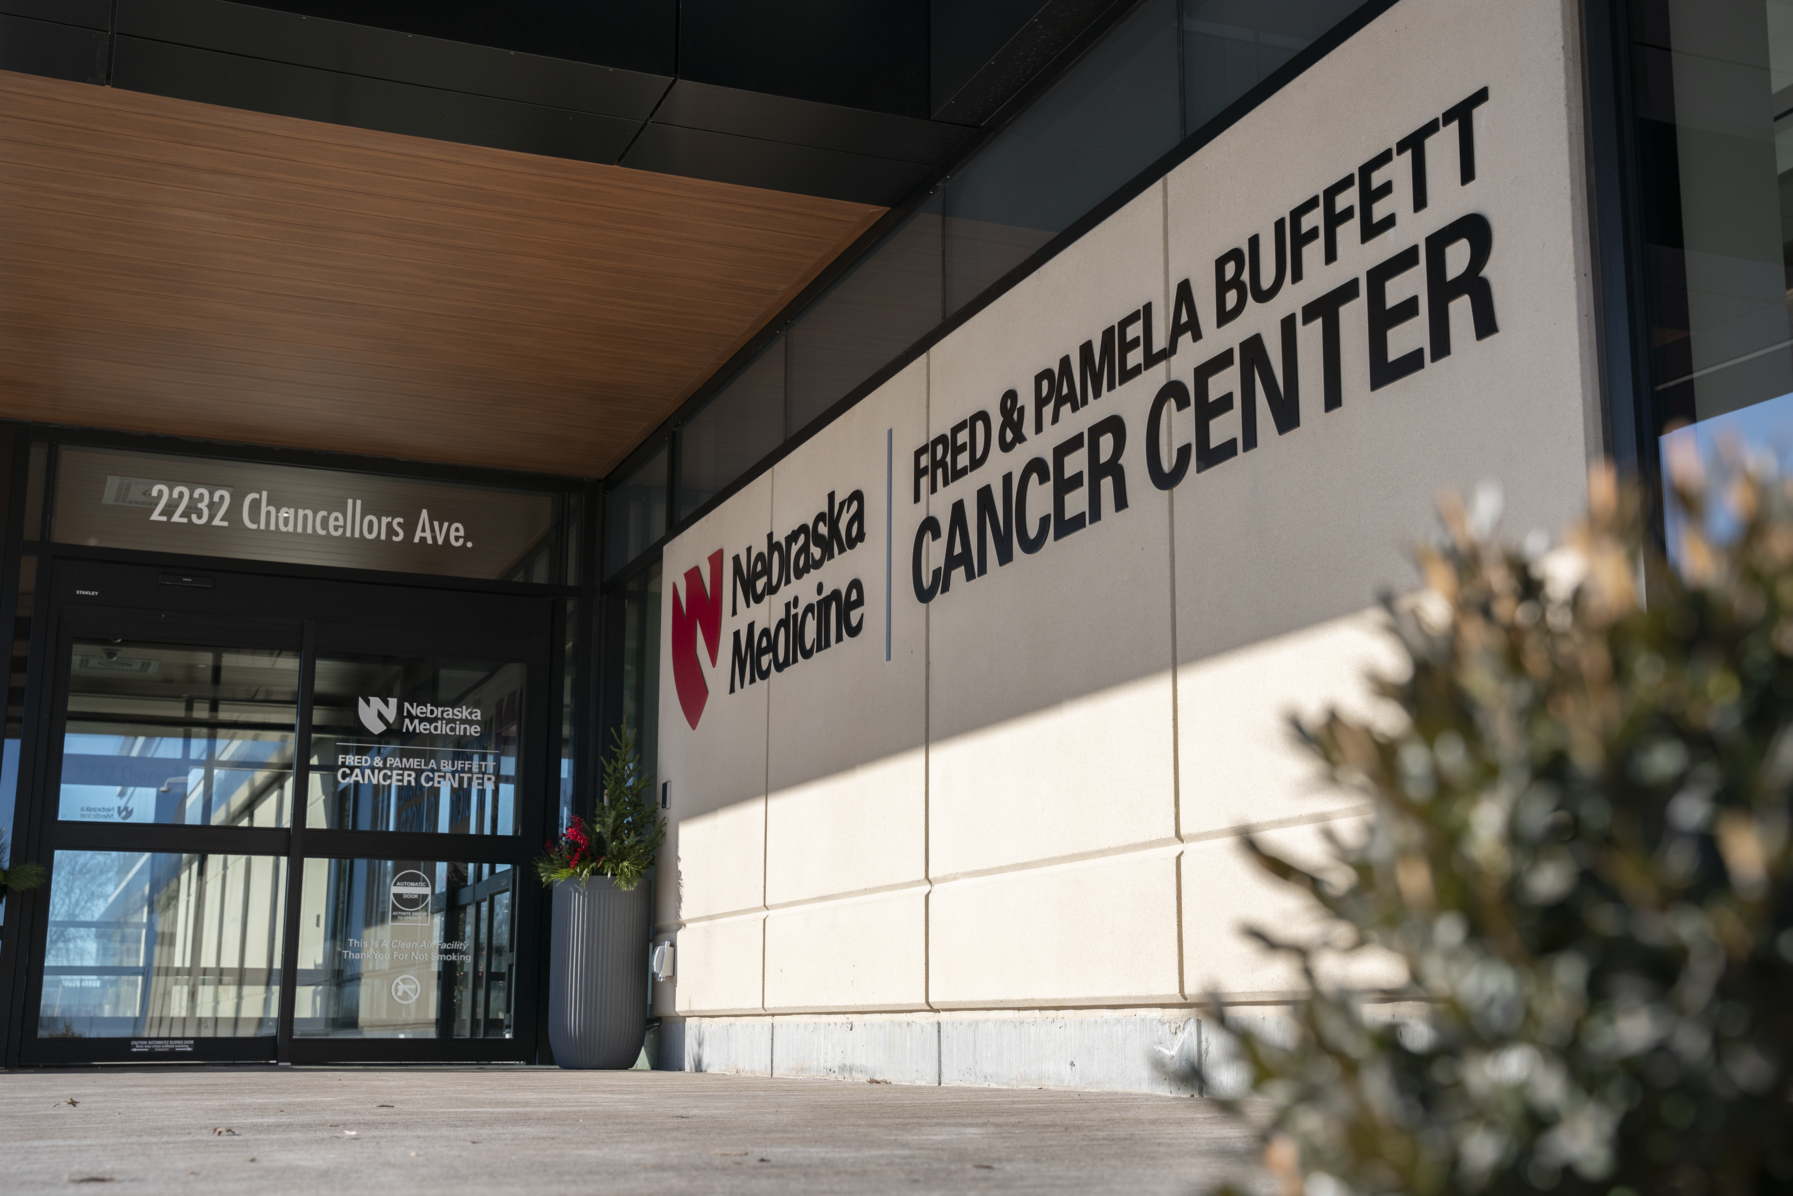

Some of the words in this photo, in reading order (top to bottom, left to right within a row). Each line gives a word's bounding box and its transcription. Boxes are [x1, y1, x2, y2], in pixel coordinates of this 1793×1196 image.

[913, 409, 992, 504] FRED
[998, 388, 1026, 453] &
[1034, 278, 1203, 435] PAMELA
[1214, 86, 1489, 329] BUFFETT
[912, 414, 1129, 604] CANCER
[1145, 212, 1499, 490] CENTER
[149, 484, 231, 526] 2232
[242, 490, 404, 542] Chancellors
[413, 508, 473, 548] Ave.
[731, 489, 866, 618] Nebraska
[729, 578, 865, 695] Medicine
[403, 702, 481, 720] Nebraska
[402, 719, 481, 736] Medicine
[338, 755, 371, 767] FRED
[373, 756, 383, 767] &
[386, 757, 437, 770] PAMELA
[440, 760, 496, 772] BUFFETT
[337, 768, 416, 786] CANCER
[420, 772, 495, 789] CENTER
[348, 939, 368, 948] This
[371, 940, 378, 948] Is
[381, 940, 388, 948] A
[391, 940, 417, 949] Clean
[419, 941, 433, 949] Air
[437, 941, 469, 951] Facility
[342, 951, 371, 960] Thank
[373, 951, 389, 960] You
[393, 952, 408, 960] For
[411, 952, 428, 961] Not
[431, 953, 472, 963] Smoking
